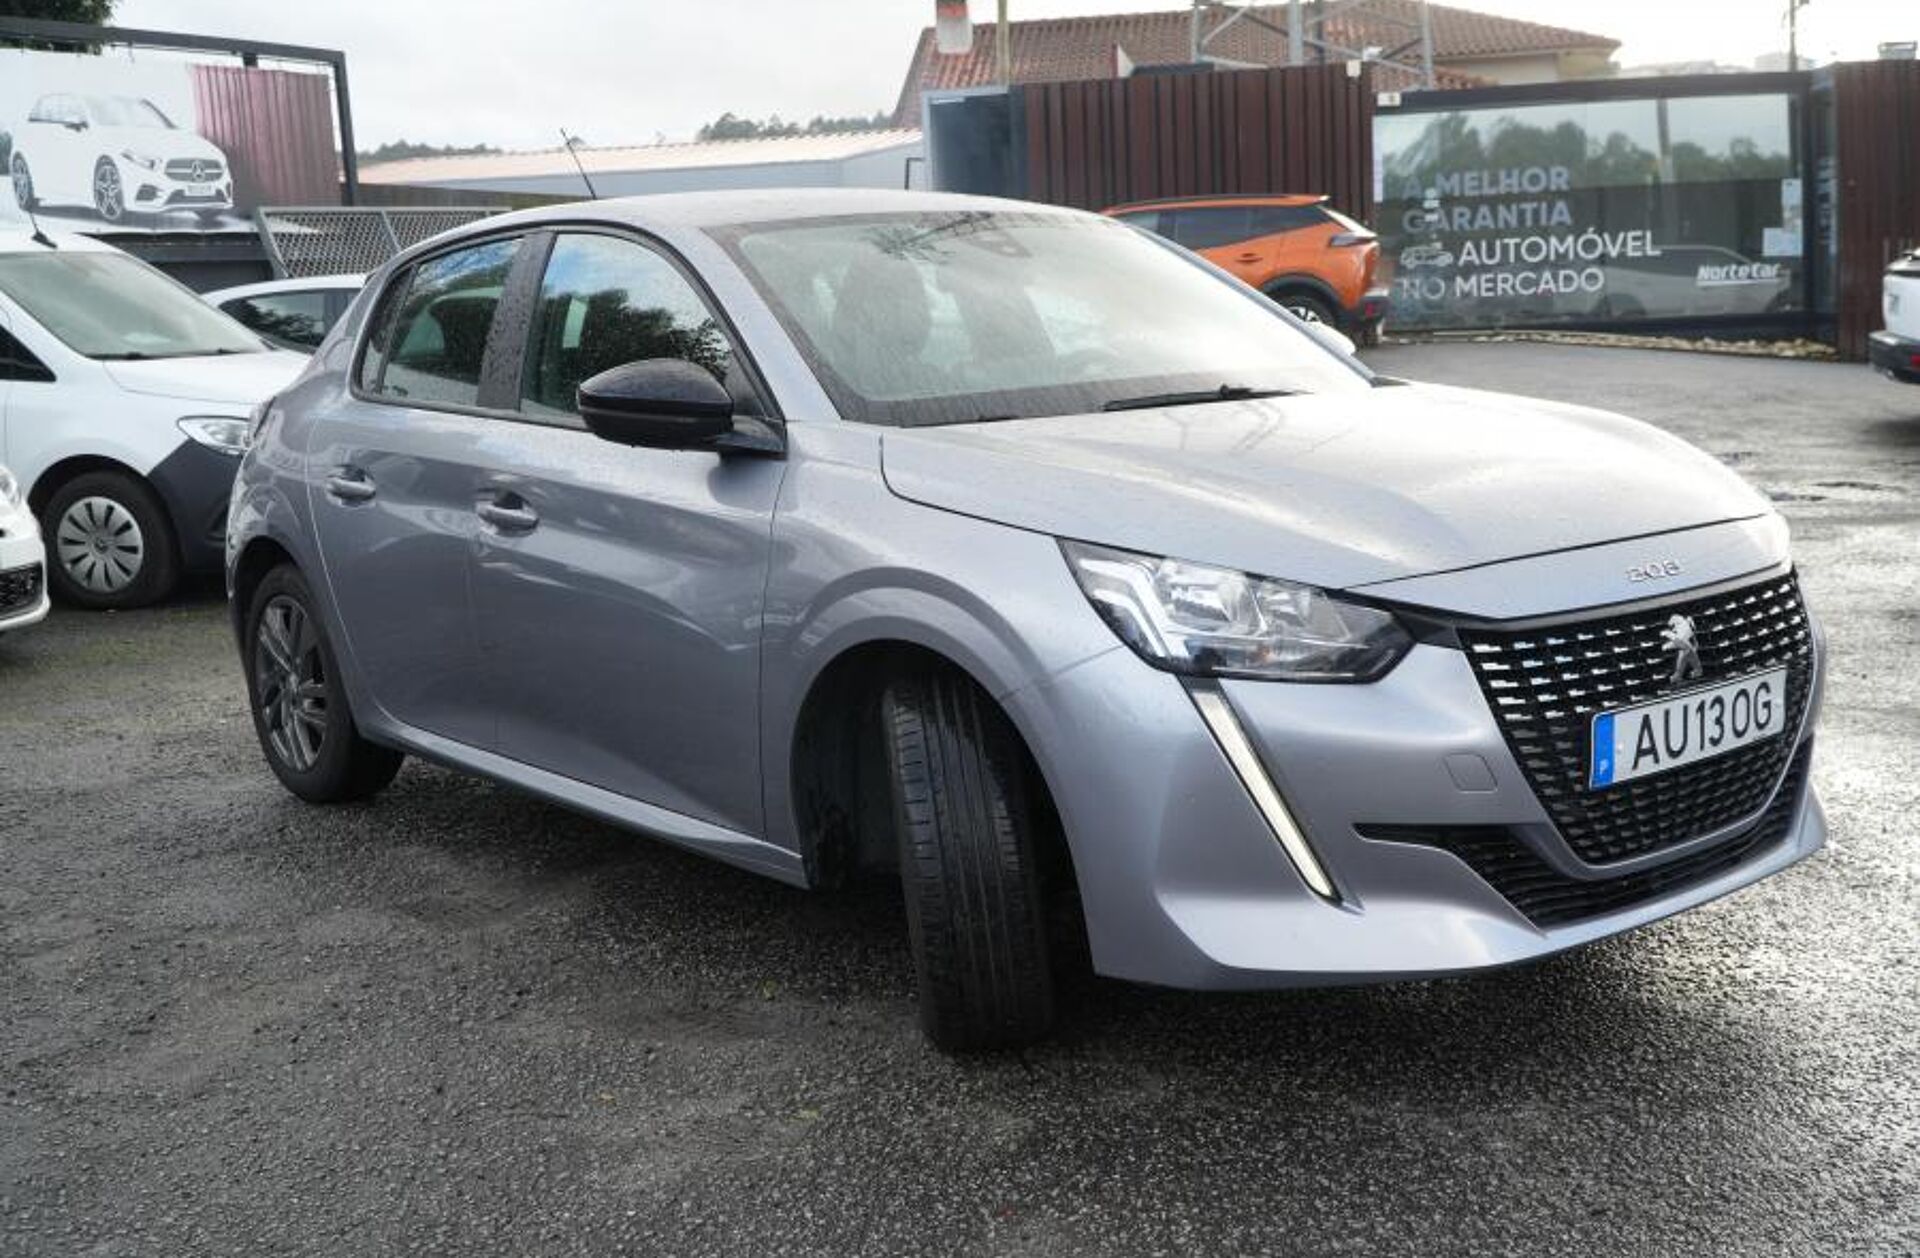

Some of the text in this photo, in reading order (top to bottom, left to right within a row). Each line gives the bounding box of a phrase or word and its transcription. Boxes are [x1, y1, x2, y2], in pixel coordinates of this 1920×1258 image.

[1401, 166, 1570, 199] A MELHOR
[1402, 200, 1572, 233] GARANTIA
[1458, 227, 1661, 267] AUTOMÓVEL
[1402, 267, 1605, 300] NO MERCADO
